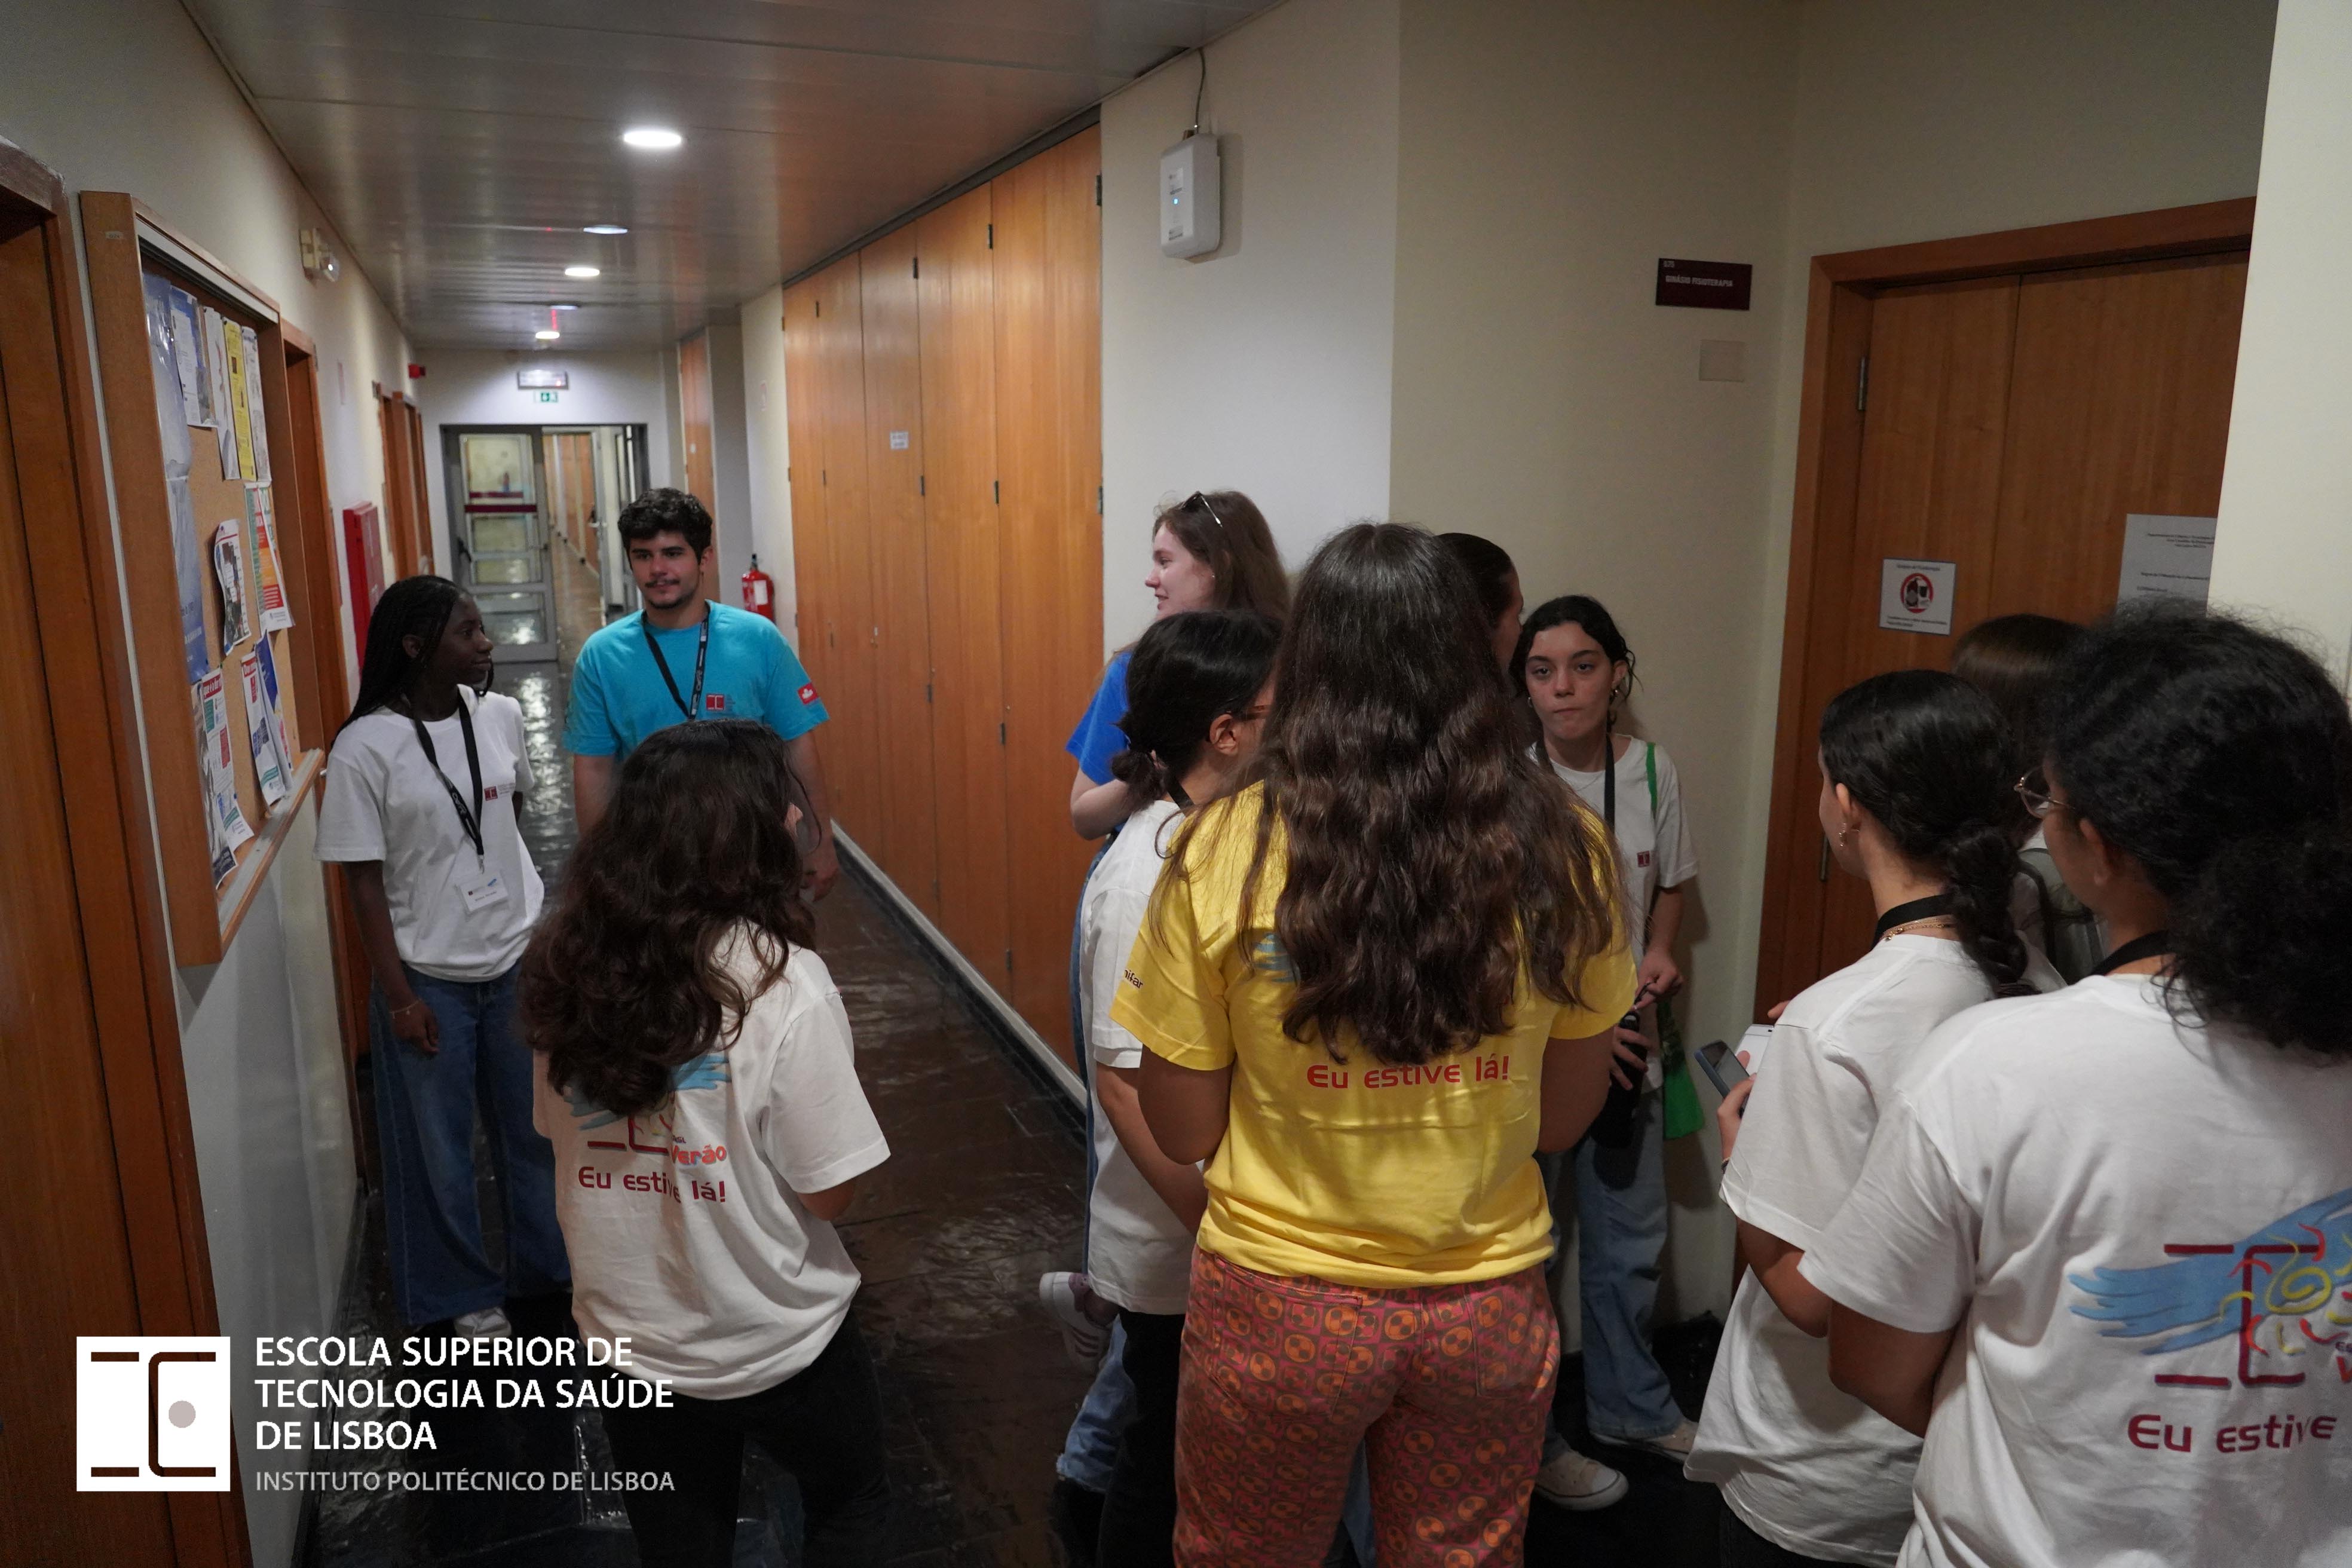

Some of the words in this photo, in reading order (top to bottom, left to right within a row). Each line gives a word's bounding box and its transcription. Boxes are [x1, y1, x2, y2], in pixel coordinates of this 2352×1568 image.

[1692, 277, 1733, 287] FISIOTERAPIA
[1306, 1064, 1348, 1089] Eu
[1364, 1063, 1460, 1088] estive
[1476, 1054, 1509, 1082] lá!
[578, 1166, 611, 1189] Eu
[623, 1171, 681, 1203] estive
[691, 1180, 725, 1202] lá!
[2128, 1414, 2192, 1453] Eu
[2216, 1414, 2337, 1453] estive
